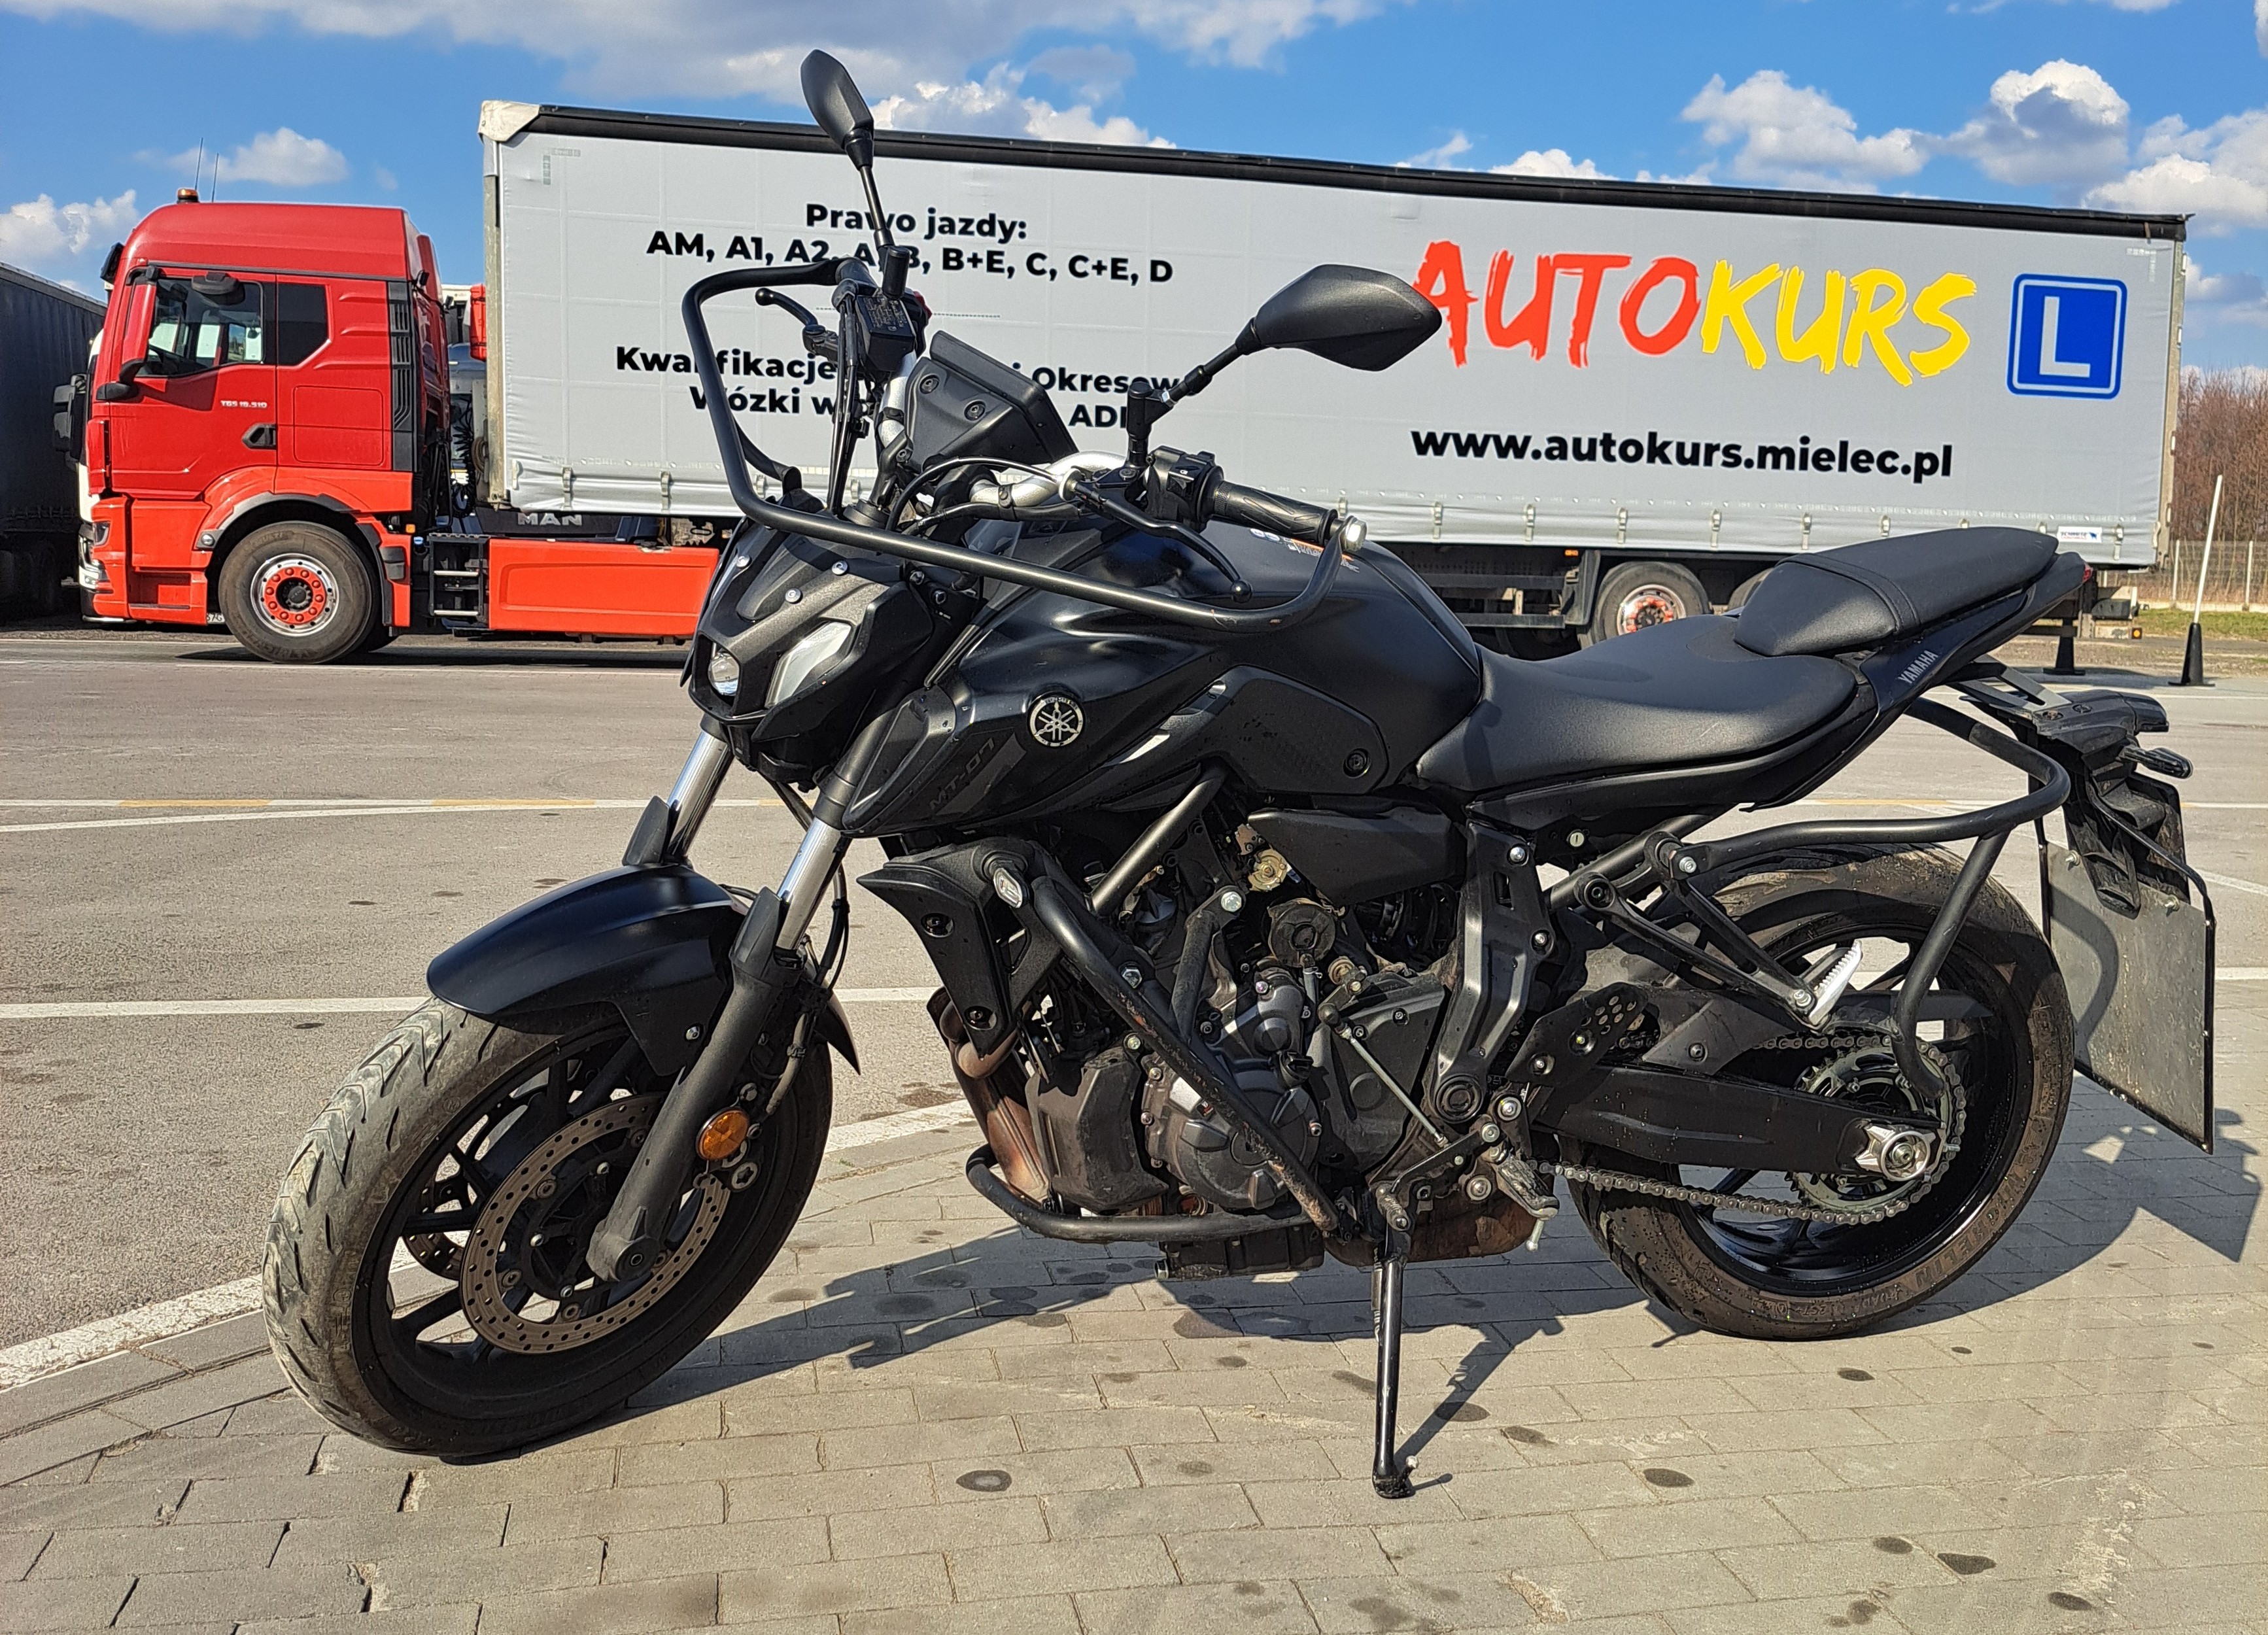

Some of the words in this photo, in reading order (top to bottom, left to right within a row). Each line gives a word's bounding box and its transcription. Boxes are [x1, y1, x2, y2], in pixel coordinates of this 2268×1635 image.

[923, 207, 1027, 243] jazdy:
[646, 231, 715, 263] AM,
[725, 235, 774, 266] A1,
[785, 239, 840, 263] A2
[943, 247, 1016, 279] B+E,
[1026, 252, 1058, 281] C,
[1068, 254, 1139, 286] C+E,
[1150, 260, 1173, 283] D
[1413, 241, 1976, 386] AUTOKURS
[2040, 297, 2089, 377] L
[617, 346, 837, 385] Kwafikacje
[1032, 366, 1196, 397] Okresw
[1411, 431, 1952, 484] www.autokurs.mielec.pl
[517, 512, 583, 526] MAN
[1897, 649, 1938, 684] YAMAHA
[929, 737, 995, 811] MT-07
